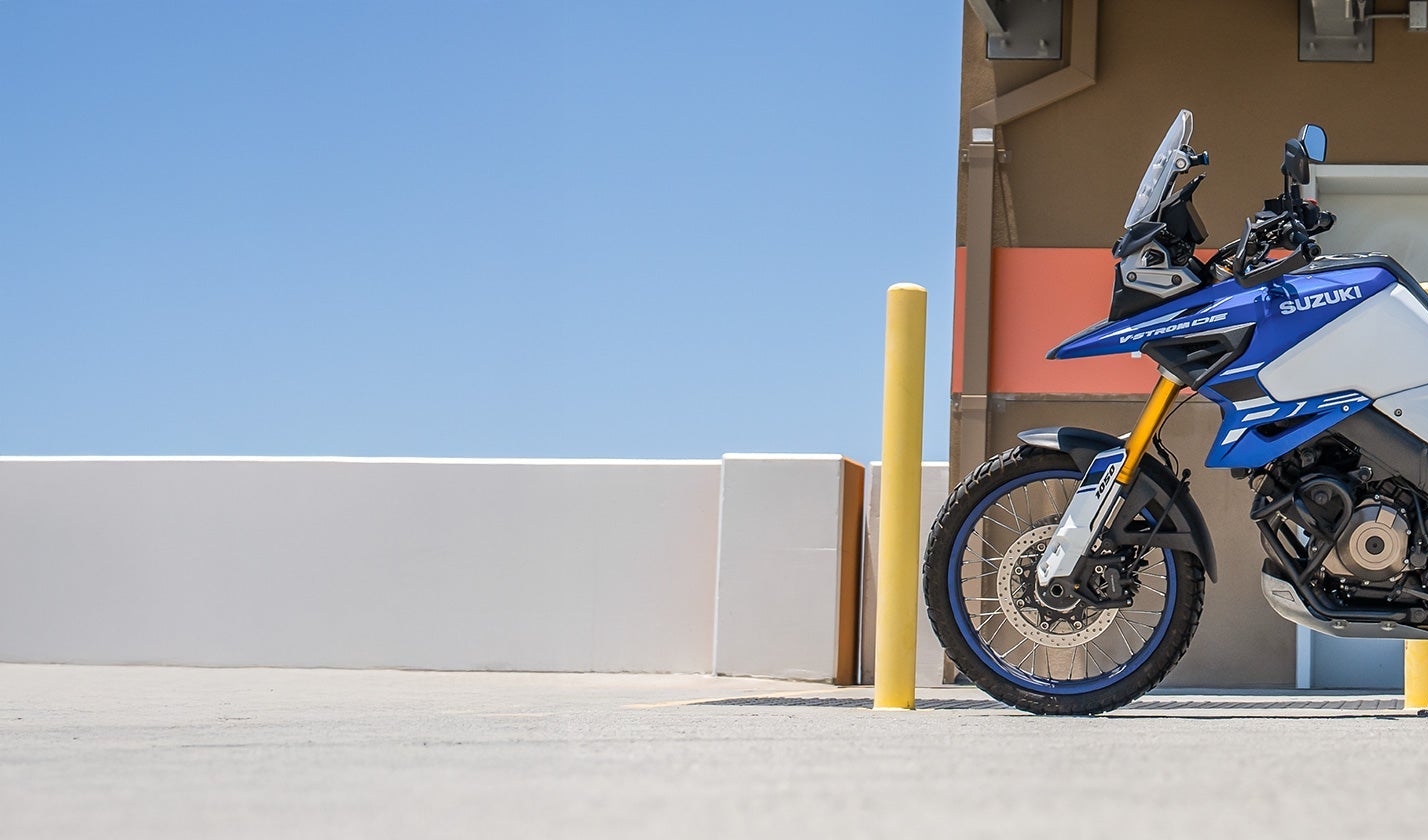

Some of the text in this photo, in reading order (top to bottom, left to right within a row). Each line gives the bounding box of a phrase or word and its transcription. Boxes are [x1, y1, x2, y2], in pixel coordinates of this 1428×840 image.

[1279, 285, 1362, 315] SUZUKI
[1191, 312, 1228, 327] DE
[1095, 464, 1115, 500] 1050
